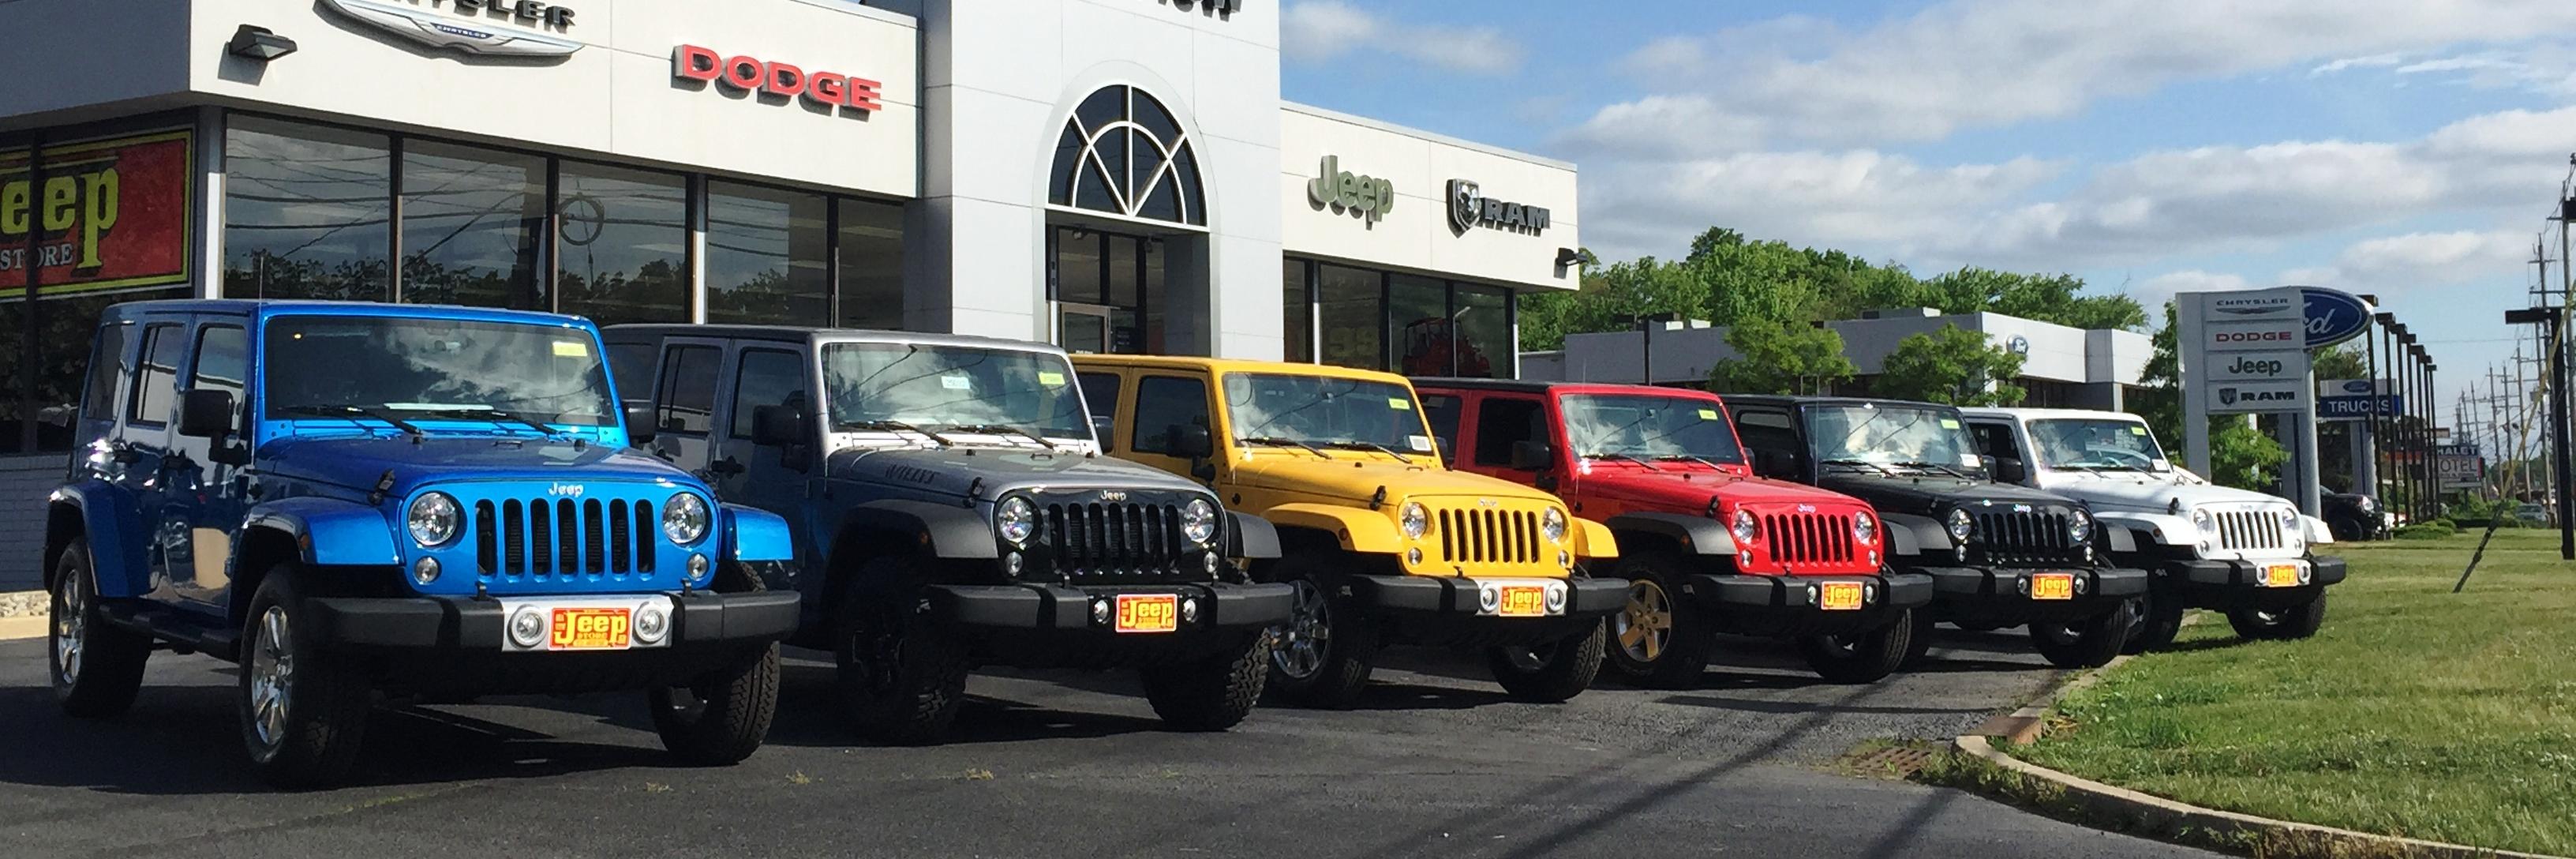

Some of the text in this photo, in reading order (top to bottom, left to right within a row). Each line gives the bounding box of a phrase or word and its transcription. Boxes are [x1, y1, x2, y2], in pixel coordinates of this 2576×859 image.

[675, 43, 882, 111] DODGE
[1308, 155, 1394, 223] Jeep
[0, 167, 119, 269] eep
[1481, 197, 1550, 229] RAM
[0, 243, 73, 270] STRE
[2215, 332, 2293, 342] DODGE
[2228, 356, 2282, 377] Jeep
[2241, 391, 2295, 401] RAM
[2440, 459, 2477, 473] OTEL
[548, 482, 584, 498] Jeep
[1099, 490, 1127, 501] Jeep
[1502, 588, 1542, 613] Jeep
[1825, 586, 1859, 606] Jeep
[1121, 600, 1174, 628] Jeep
[554, 612, 627, 644] Jeep
